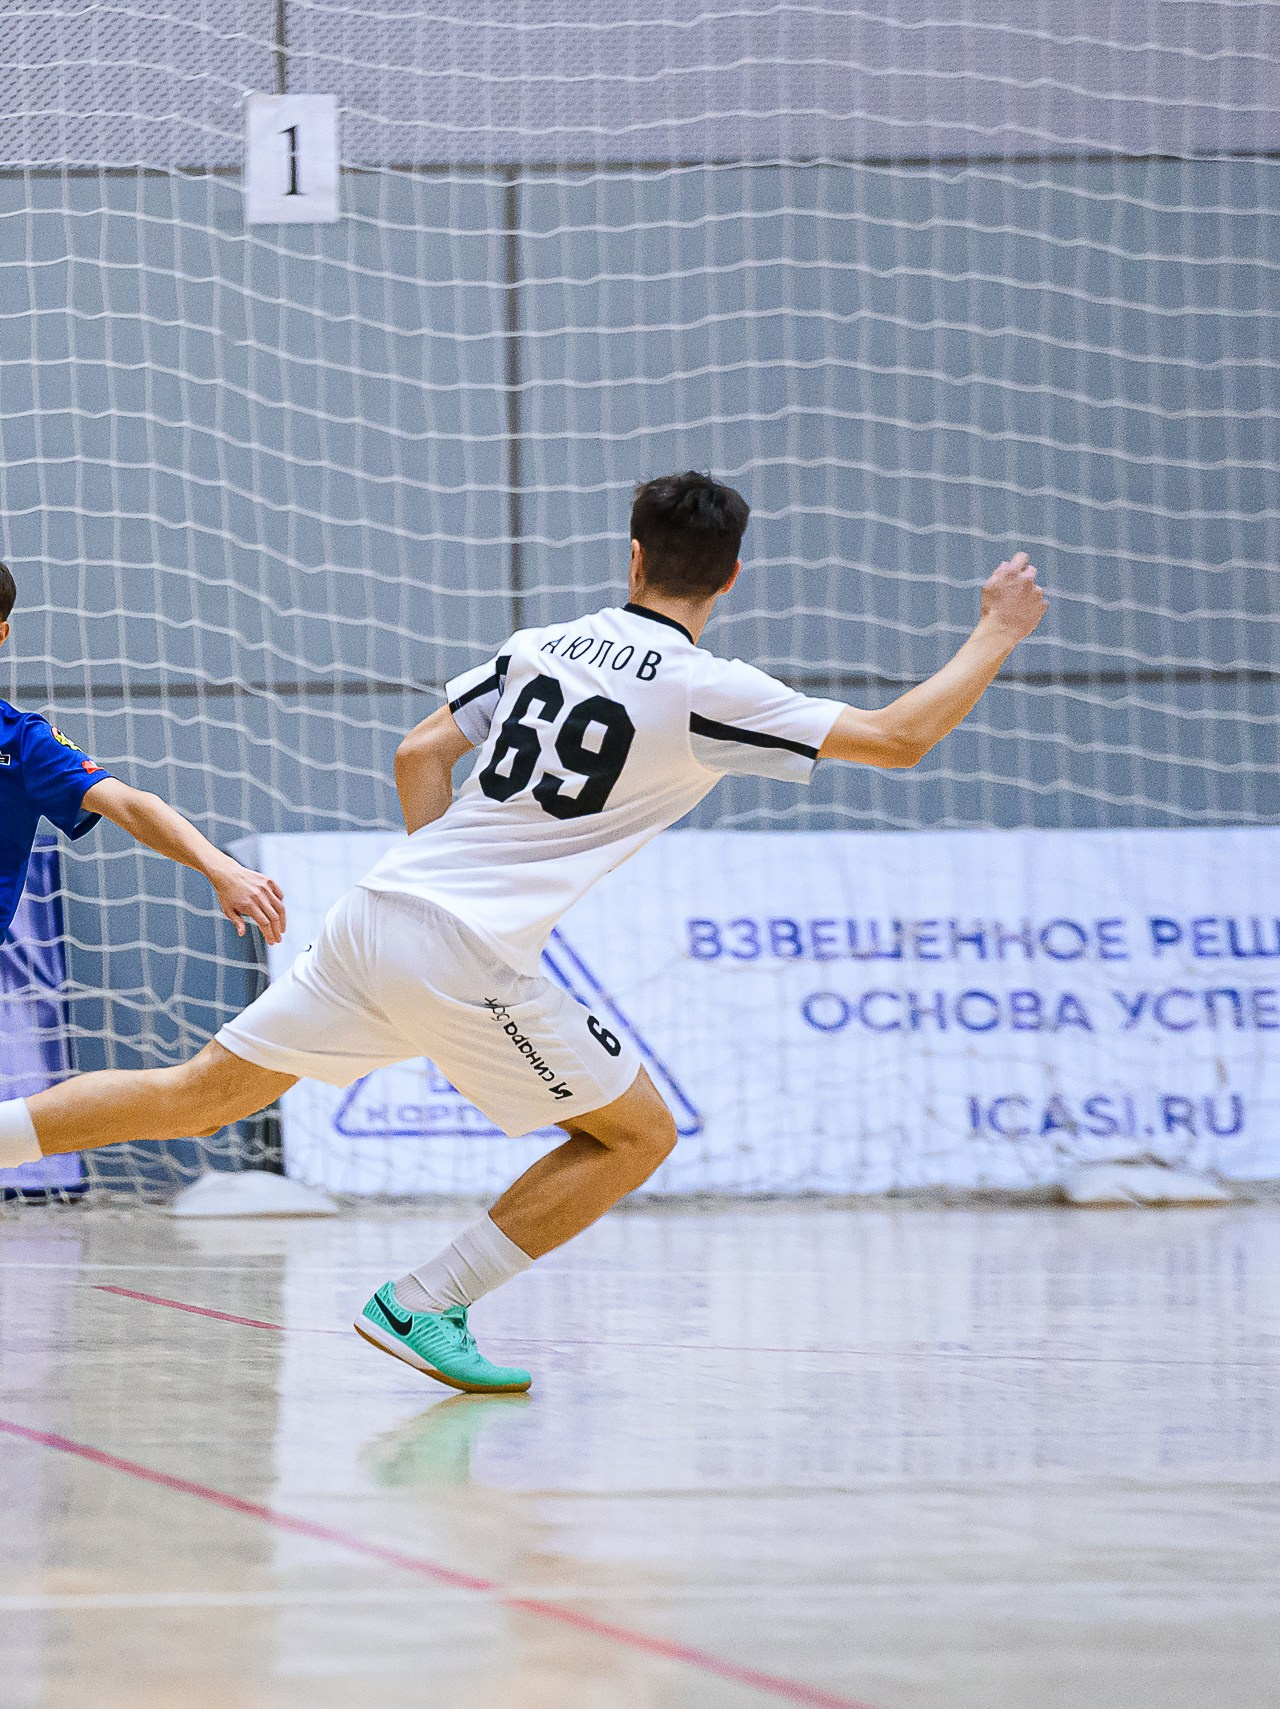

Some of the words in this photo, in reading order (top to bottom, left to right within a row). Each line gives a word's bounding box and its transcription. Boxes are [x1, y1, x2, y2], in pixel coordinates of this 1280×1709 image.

[277, 125, 308, 196] 1
[479, 674, 636, 820] 69
[687, 917, 1129, 960] ВЗВЕШЕННОЕ
[801, 989, 1093, 1033] ОСНОВА
[587, 1015, 622, 1057] 6
[968, 1094, 1245, 1138] ICASI.RU
